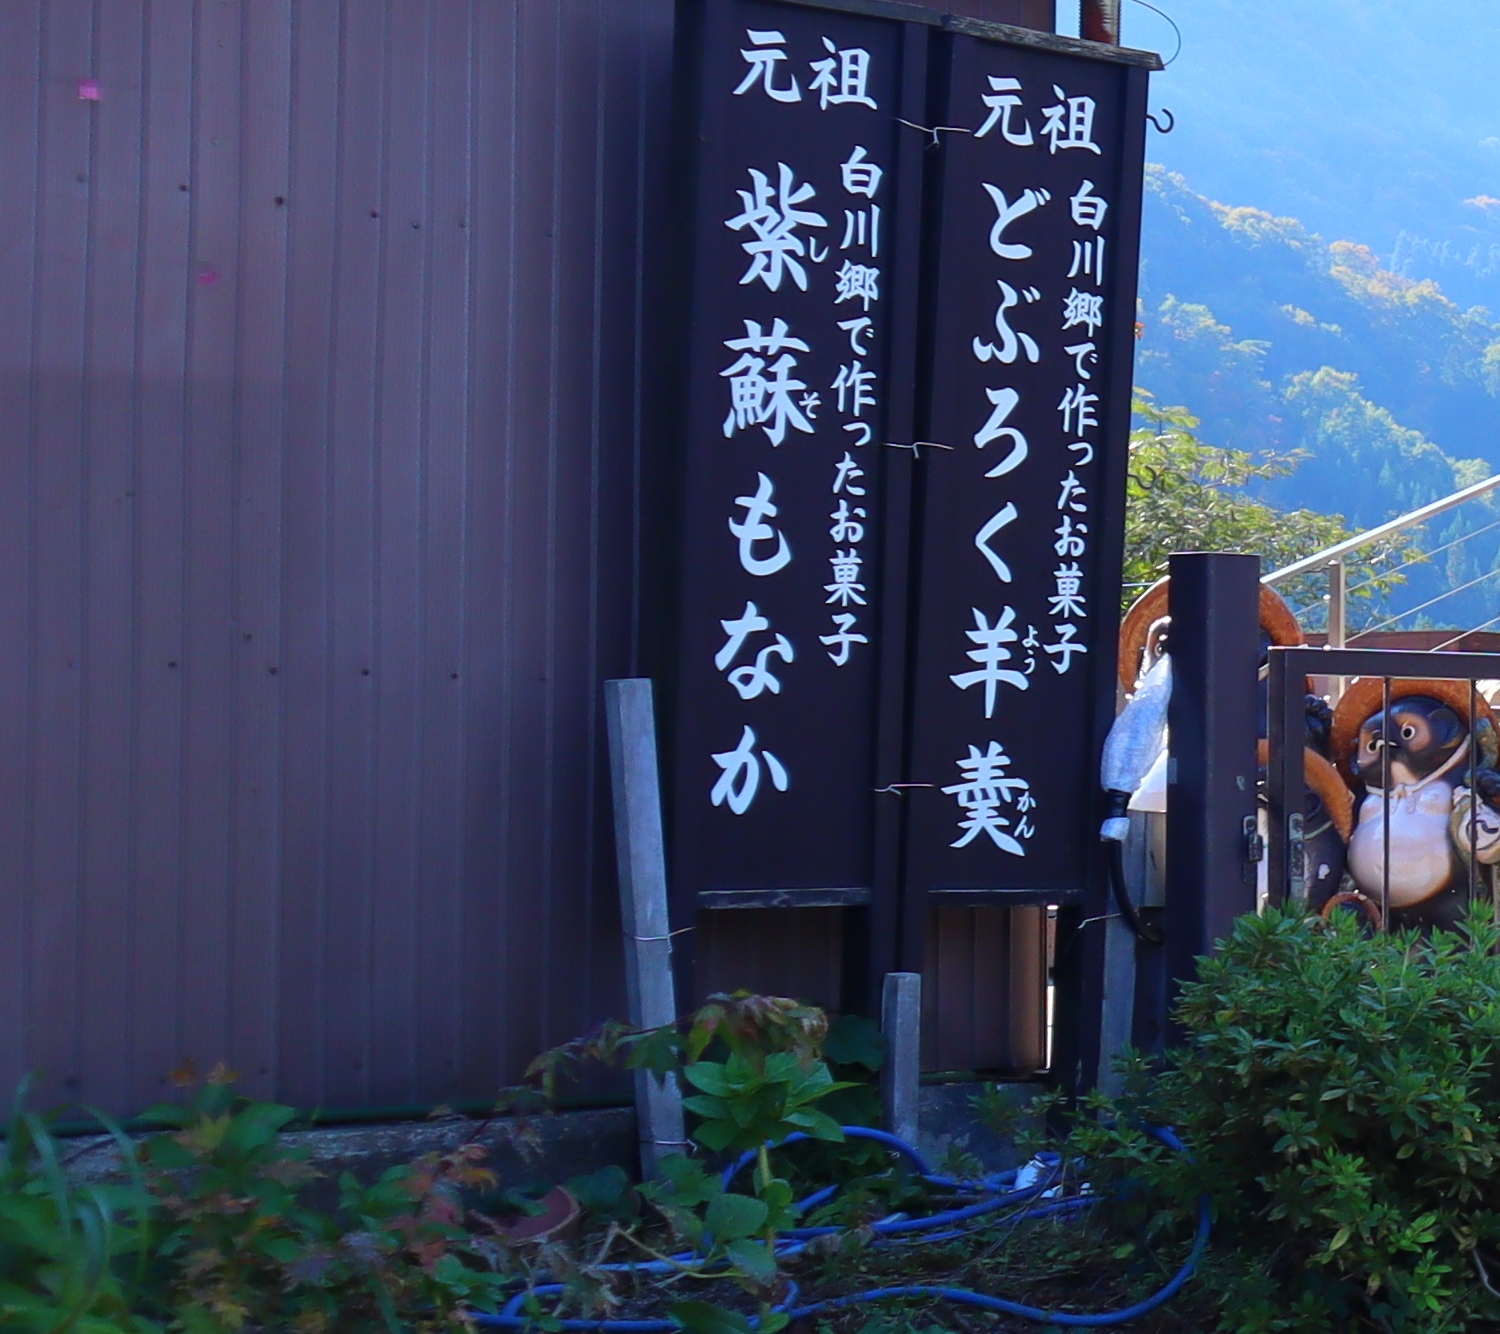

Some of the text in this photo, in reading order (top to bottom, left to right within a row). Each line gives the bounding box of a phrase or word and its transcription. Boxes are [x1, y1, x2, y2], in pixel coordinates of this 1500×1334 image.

[732, 28, 878, 111] 元祖
[973, 75, 1102, 155] 元祖
[710, 161, 828, 816] 紫蘇もなか
[818, 145, 883, 668] 白川郷で作ったお菓子
[940, 180, 1052, 857] どぶろく羊羹
[1042, 179, 1108, 676] 白川郷で作ったお菓子
